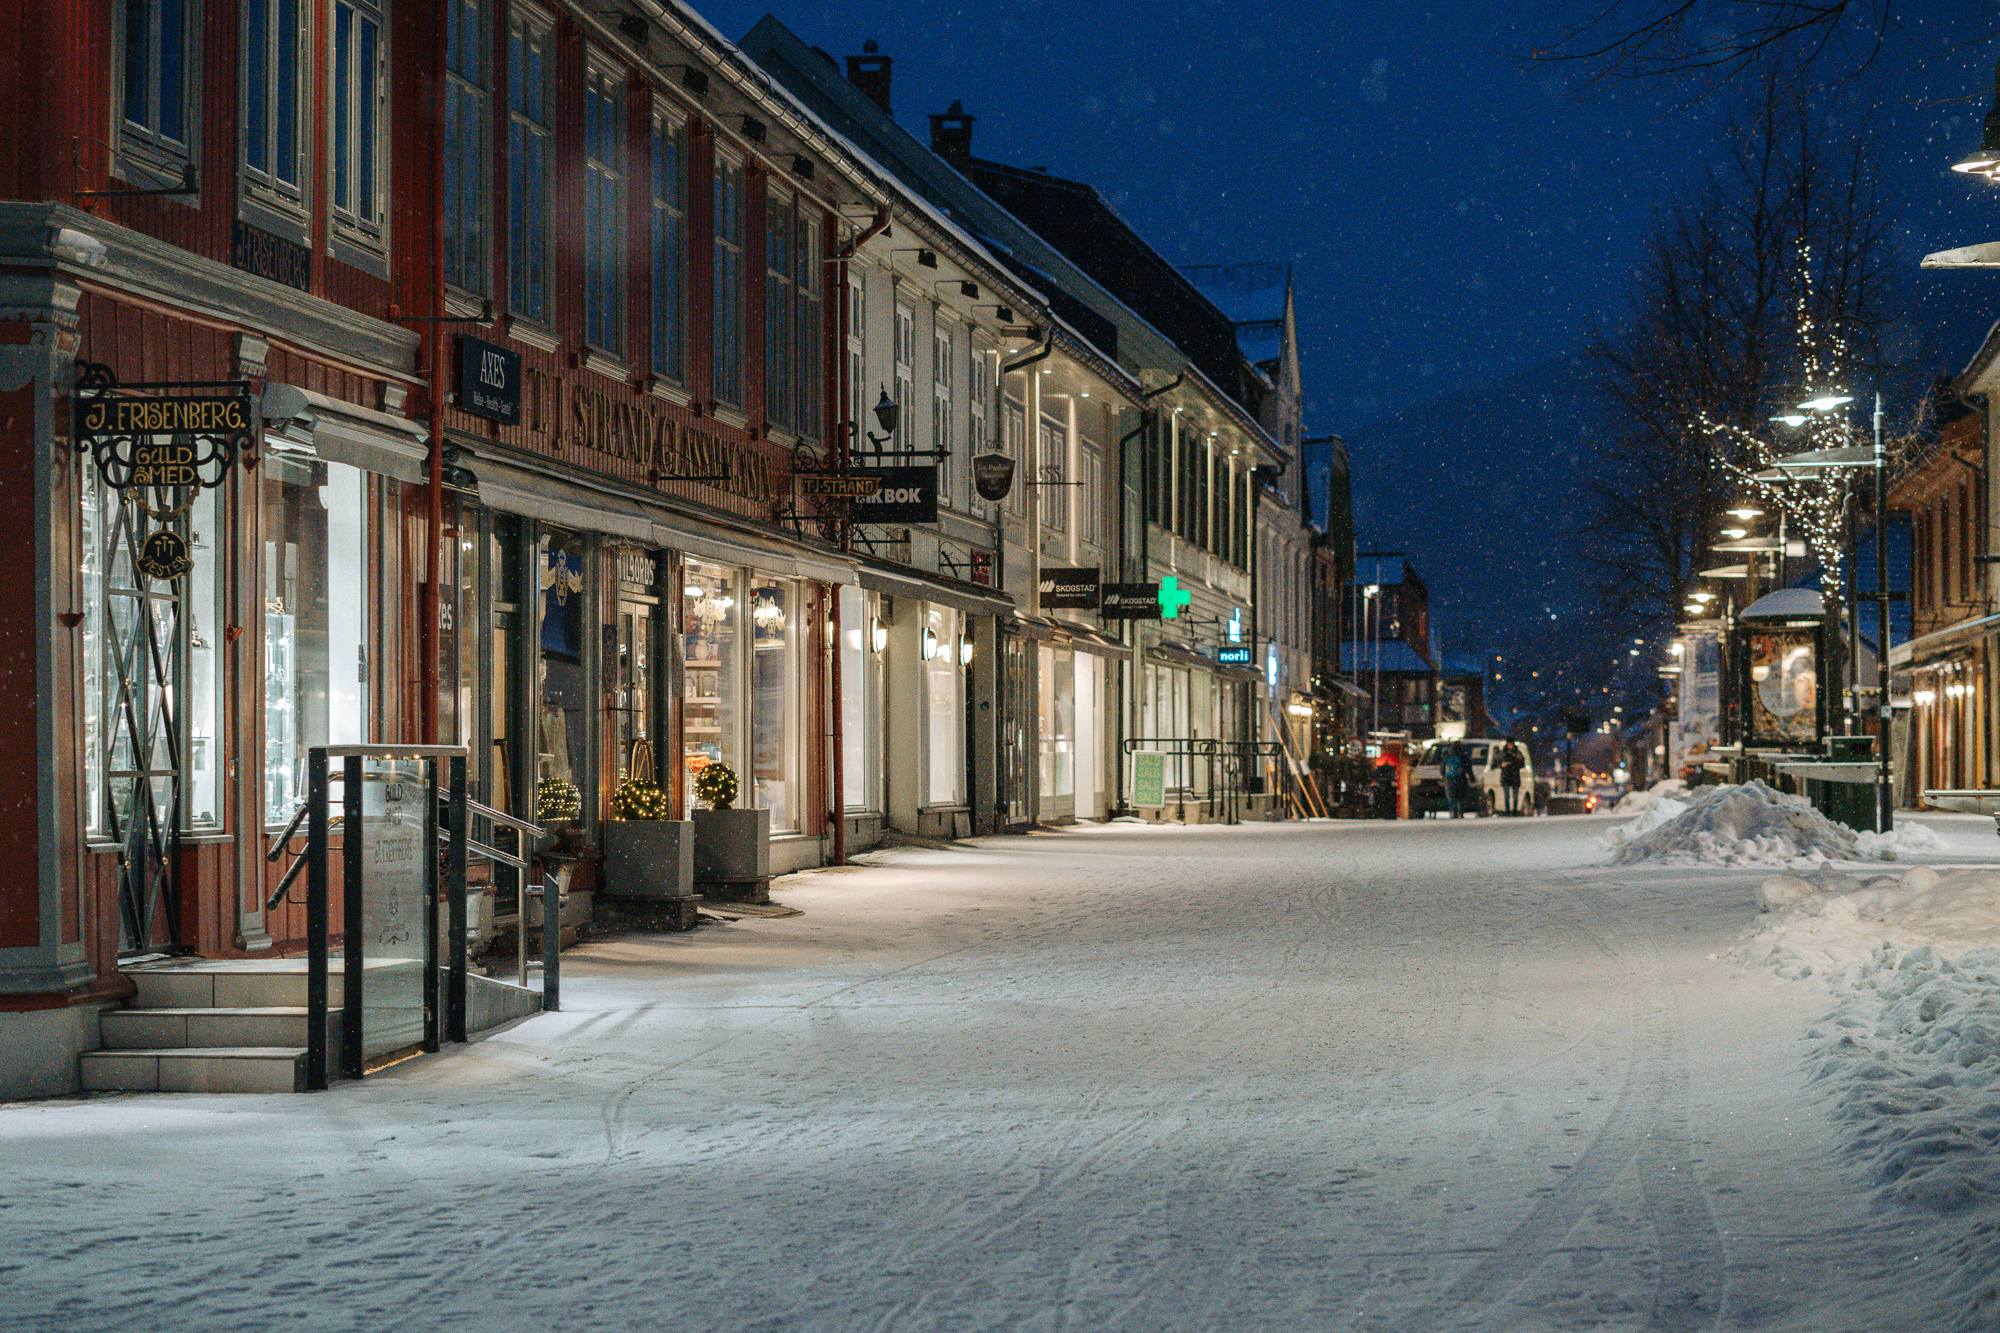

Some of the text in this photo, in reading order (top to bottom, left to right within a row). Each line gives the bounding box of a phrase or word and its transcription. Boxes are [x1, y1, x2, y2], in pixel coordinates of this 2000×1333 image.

[480, 349, 505, 389] AXES
[574, 385, 653, 466] STRAND
[135, 446, 193, 465] GULD
[133, 465, 195, 485] SMED
[885, 487, 921, 504] BOK
[144, 555, 186, 577] MESTER
[1056, 584, 1095, 593] SKOGSTAD
[1120, 597, 1155, 605] SKOGSTAD
[1219, 650, 1249, 661] norli
[1138, 755, 1160, 766] SALG
[1138, 767, 1160, 778] SALG
[1138, 780, 1160, 790] SALG
[1138, 792, 1160, 803] SALG
